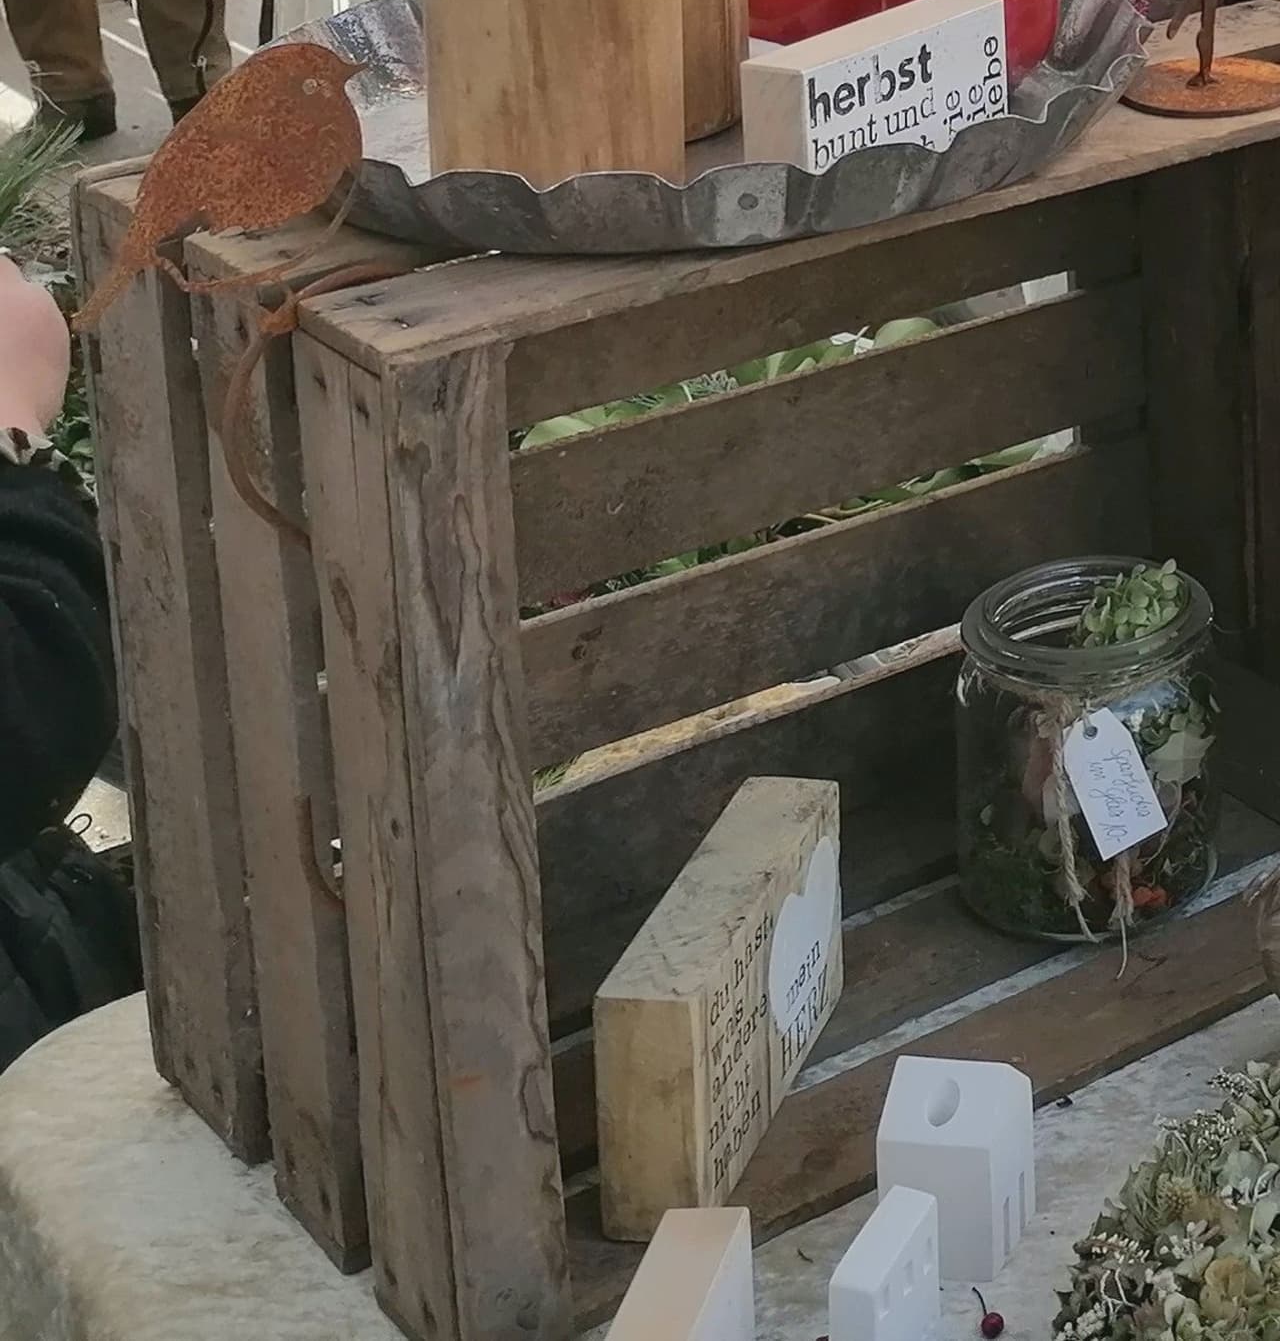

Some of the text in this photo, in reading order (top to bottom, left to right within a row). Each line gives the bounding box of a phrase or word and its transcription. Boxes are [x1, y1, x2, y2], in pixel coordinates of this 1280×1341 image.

[807, 43, 932, 129] herbst
[812, 86, 937, 170] bunt und
[786, 939, 821, 1013] mein
[712, 991, 768, 1103] andere
[714, 1090, 761, 1189] haben
